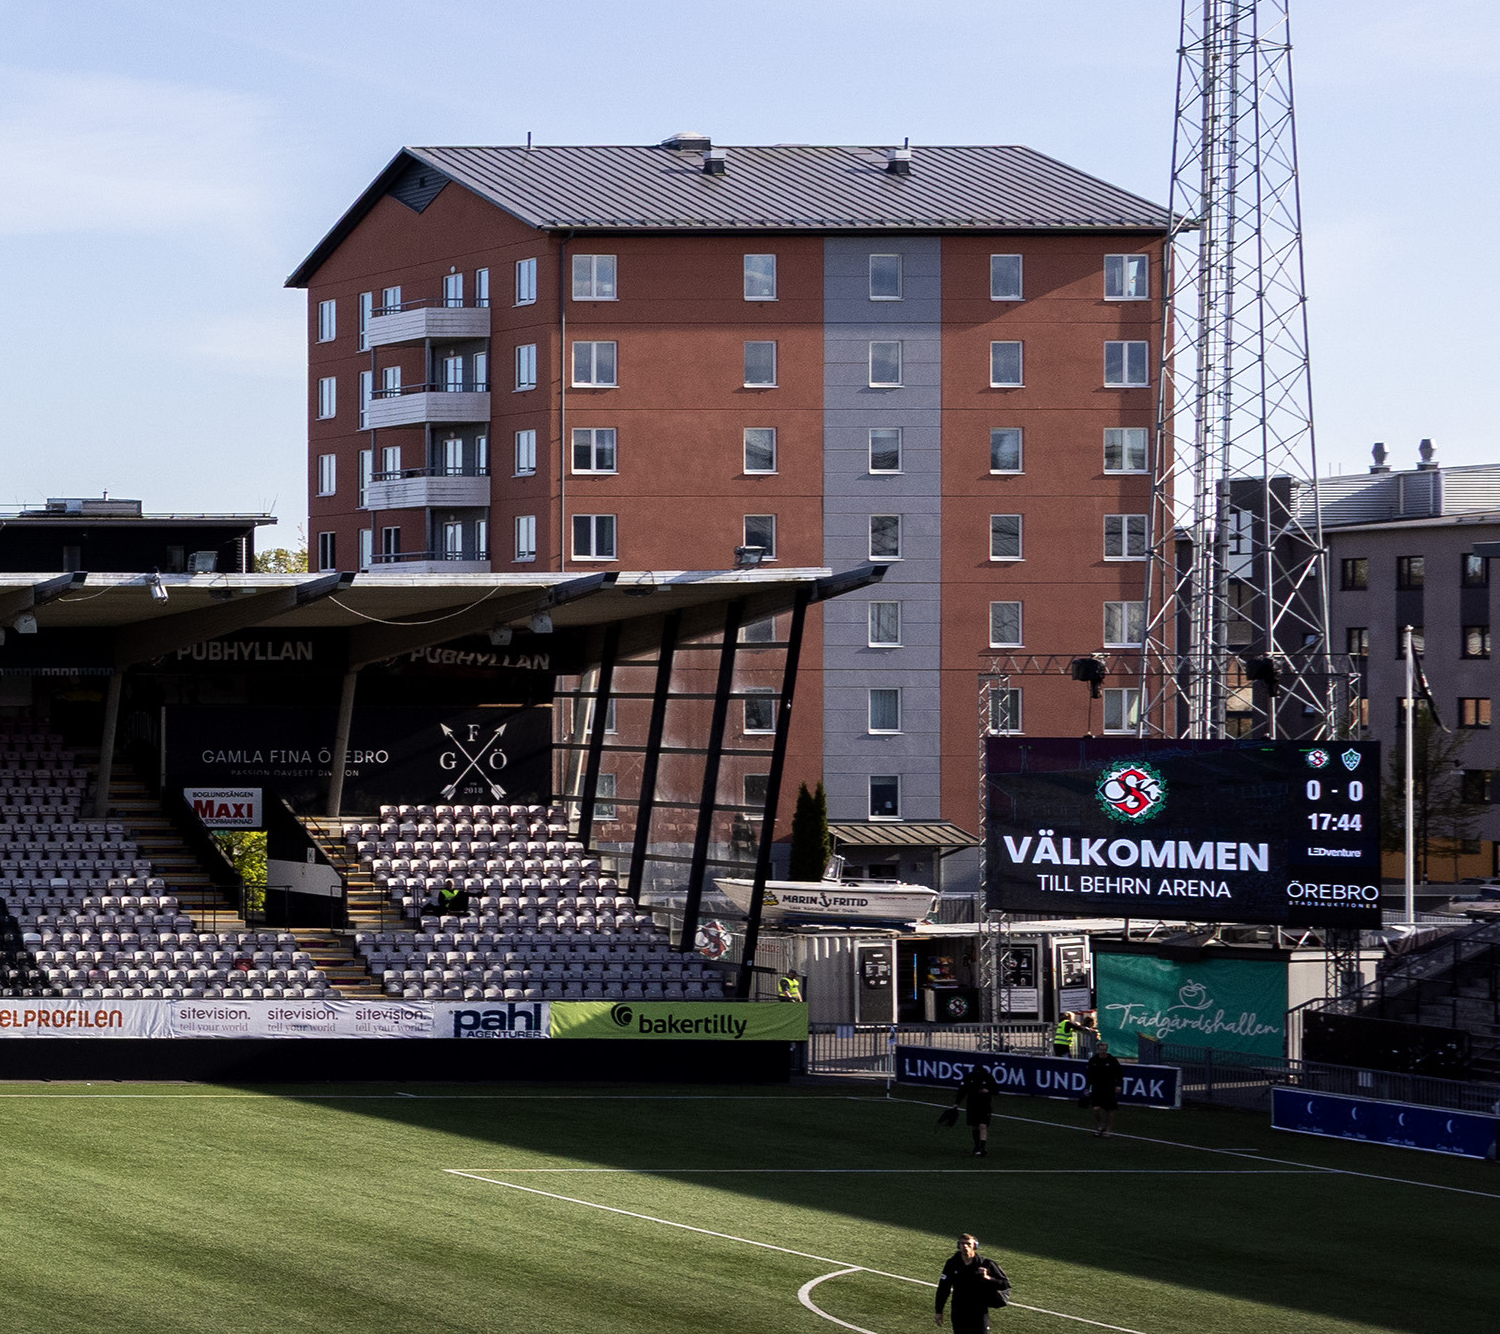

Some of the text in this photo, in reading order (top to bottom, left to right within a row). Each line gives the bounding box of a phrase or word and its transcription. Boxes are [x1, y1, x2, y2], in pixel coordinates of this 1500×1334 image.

[177, 640, 313, 661] PUBHYLLAN
[409, 647, 550, 670] PUBHYLLAN
[201, 746, 389, 764] GAMLA FINA ÖEBRO
[439, 751, 457, 770] G
[1306, 780, 1363, 801] 0 0
[1307, 813, 1362, 831] 17:44
[1003, 829, 1269, 872] VÄLKOMMEN
[1037, 874, 1232, 898] TILL BEHRN ARENA
[1287, 880, 1379, 901] ÖREBRO
[782, 894, 817, 904] MARIN
[833, 897, 868, 907] FRITID
[180, 1007, 251, 1021] sitevision.
[268, 1007, 339, 1021] sitevision.
[356, 1007, 427, 1021] sitevision.
[453, 1003, 541, 1037] pahl
[1105, 1003, 1279, 1039] Trädgårdshallen
[180, 1022, 248, 1034] tell your world
[268, 1022, 336, 1034] tell your world
[356, 1022, 424, 1034] tell your world
[639, 1014, 747, 1039] bakertilly
[905, 1059, 1026, 1086] LINDSTÖM
